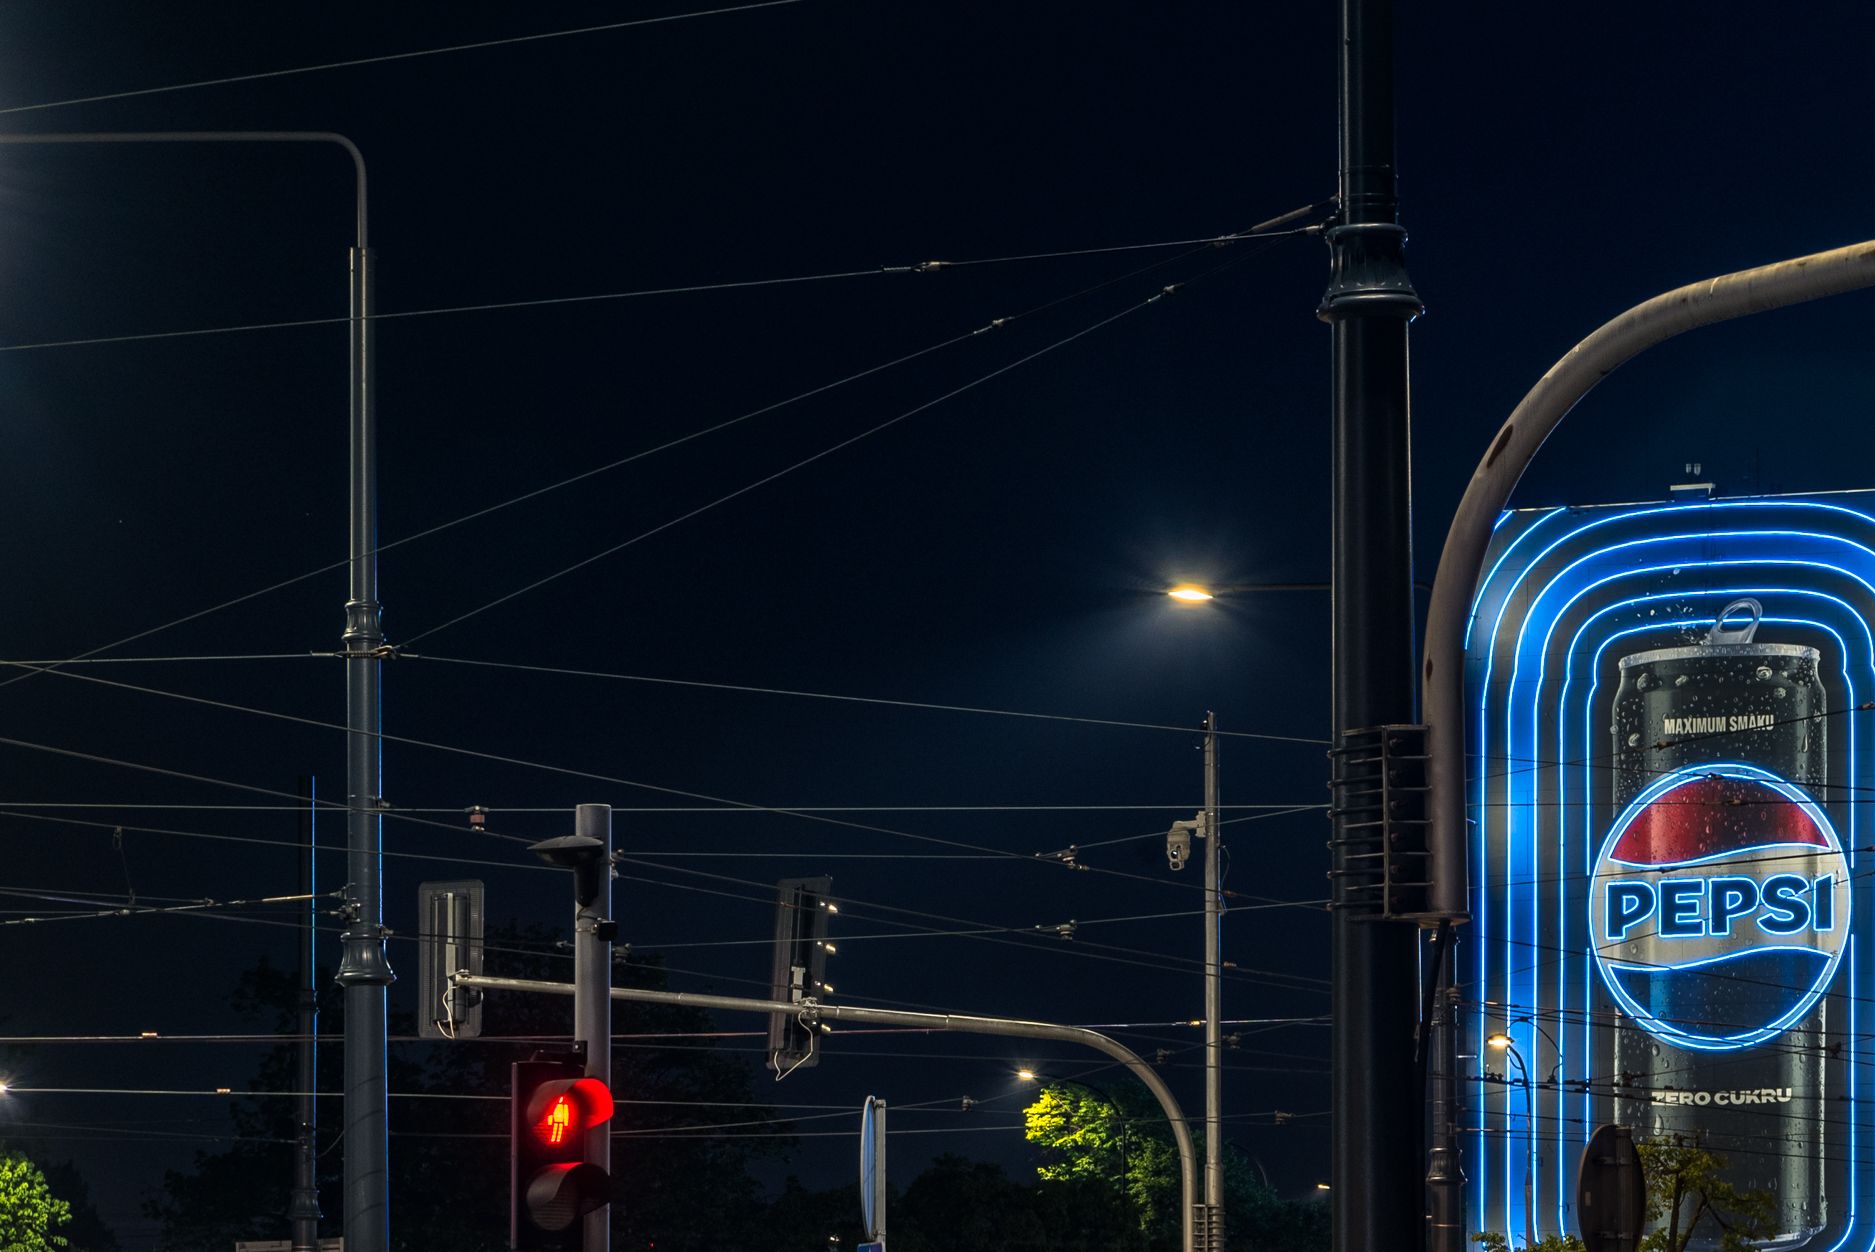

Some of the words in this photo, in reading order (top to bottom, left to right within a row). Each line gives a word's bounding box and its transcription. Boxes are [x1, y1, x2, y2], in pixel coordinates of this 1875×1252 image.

[1664, 717, 1726, 734] MAXIMUM
[1729, 714, 1775, 732] SMAKU
[1605, 873, 1834, 940] PEPSI
[1651, 1091, 1711, 1106] ZERO
[1713, 1088, 1792, 1106] CUKRU
